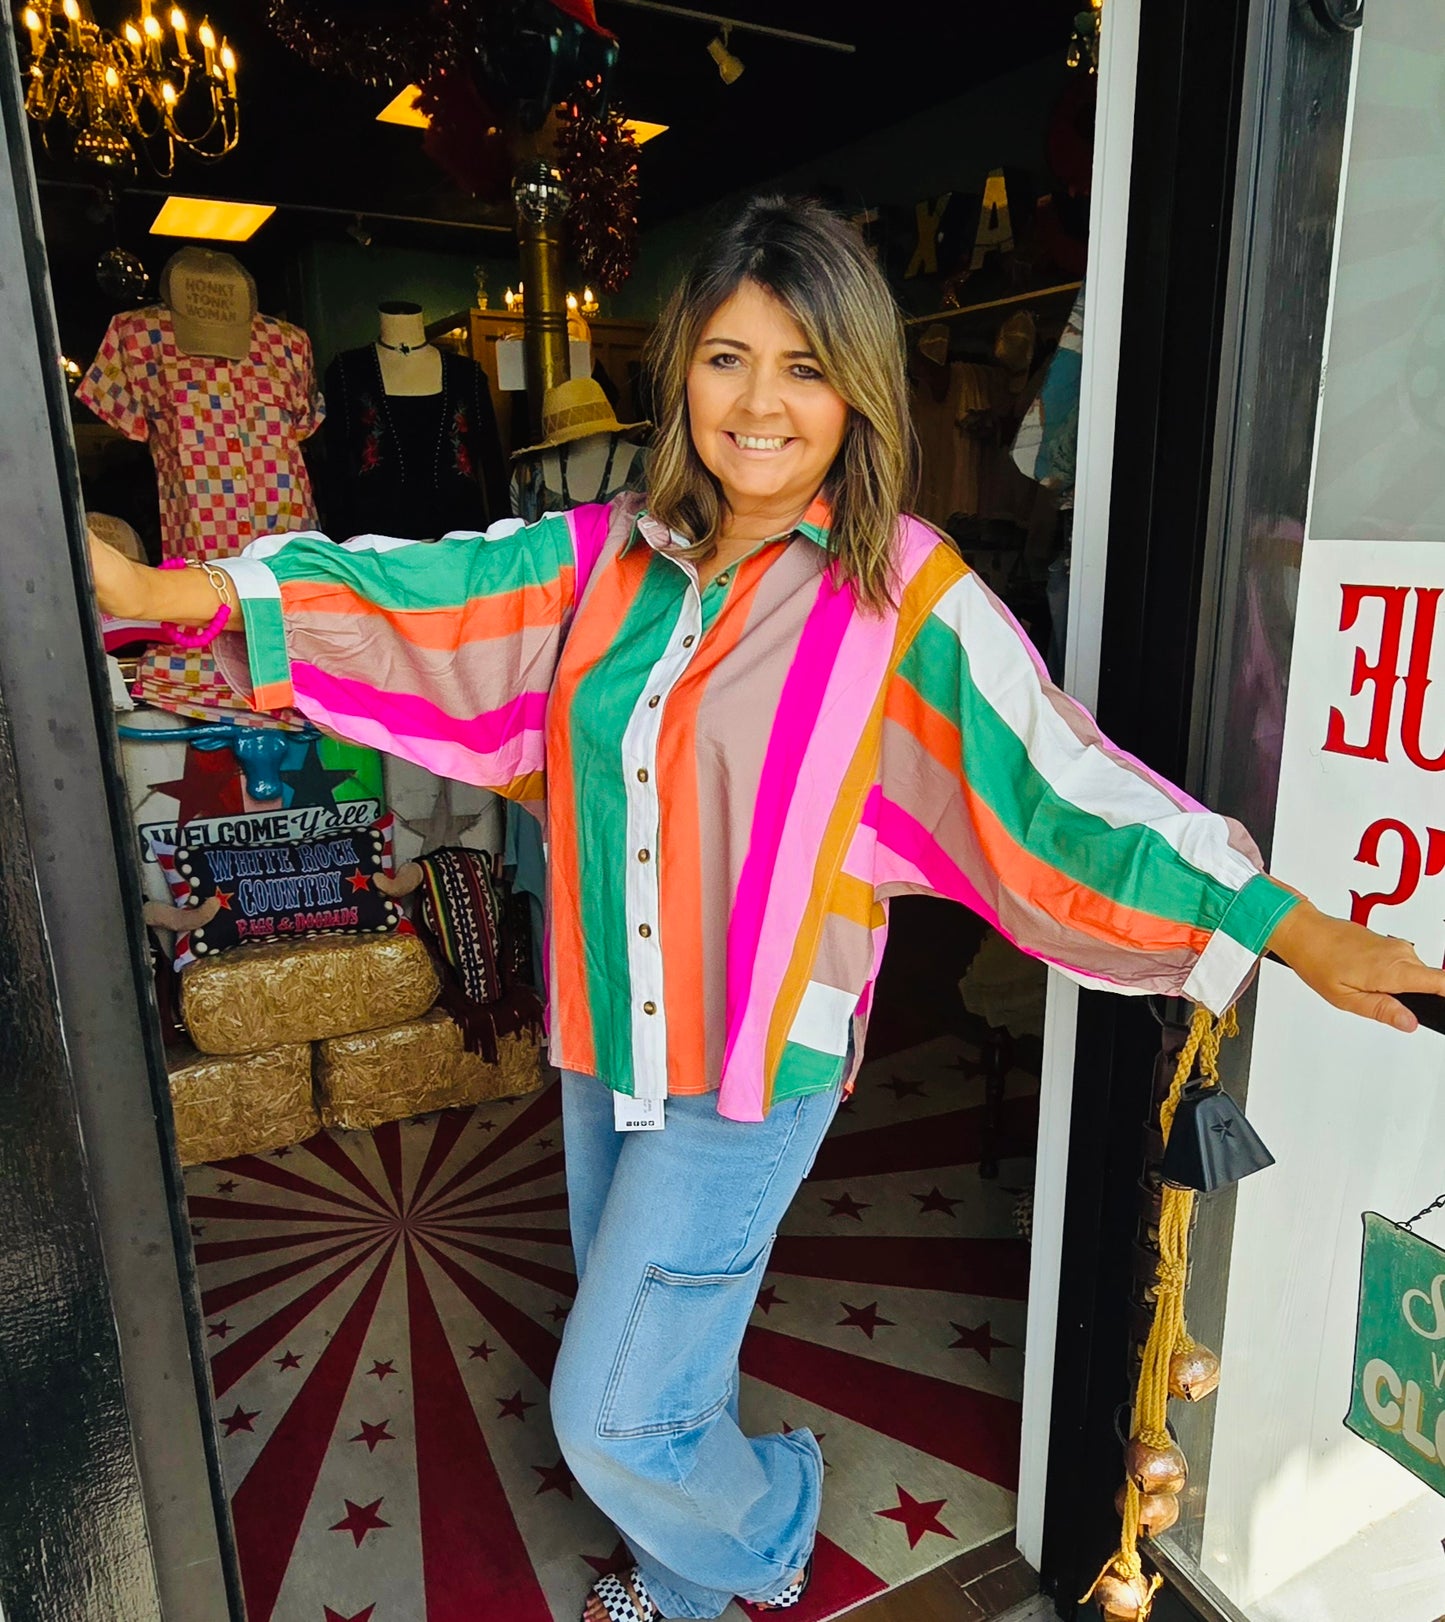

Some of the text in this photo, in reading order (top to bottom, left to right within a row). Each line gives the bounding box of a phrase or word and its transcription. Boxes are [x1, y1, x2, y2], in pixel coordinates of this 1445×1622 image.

[185, 278, 235, 297] HONKY
[150, 815, 288, 846] WELCOME
[204, 838, 360, 883] WHITE ROCK
[238, 871, 343, 917] COUNTRY
[1361, 1358, 1445, 1467] CL
